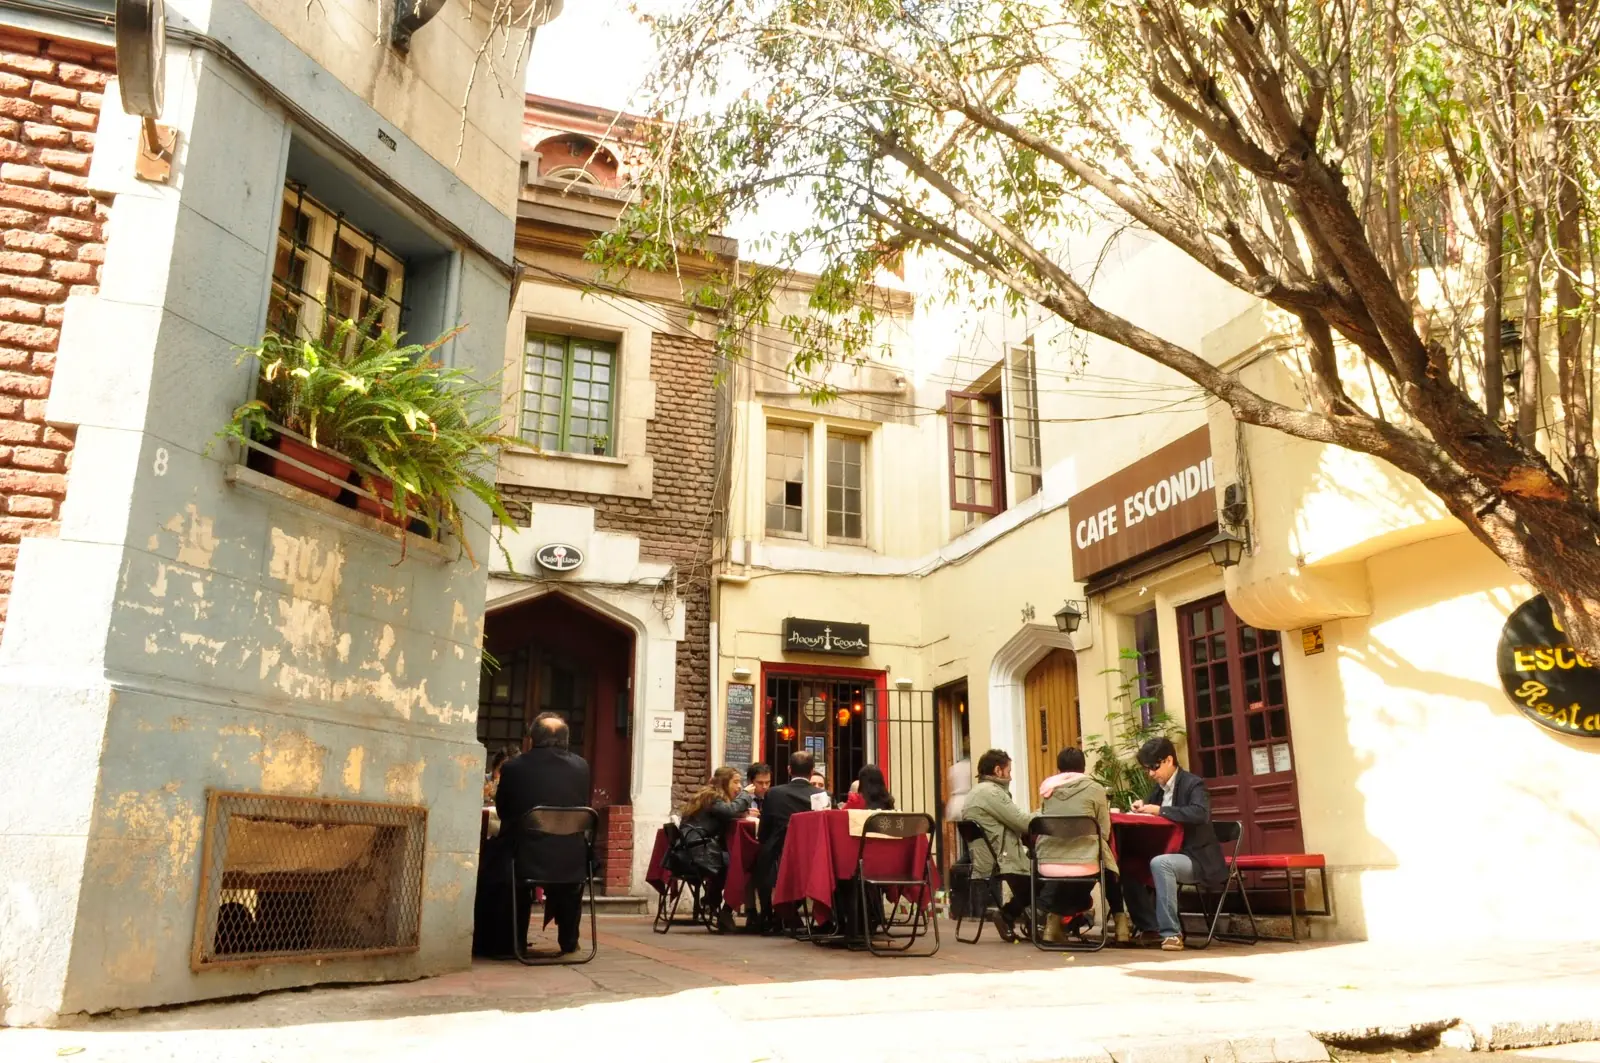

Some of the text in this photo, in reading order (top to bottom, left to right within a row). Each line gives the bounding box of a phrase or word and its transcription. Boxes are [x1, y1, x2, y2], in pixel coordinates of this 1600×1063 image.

[153, 447, 169, 477] 8
[1076, 504, 1118, 550] CAFE
[654, 720, 672, 729] 344
